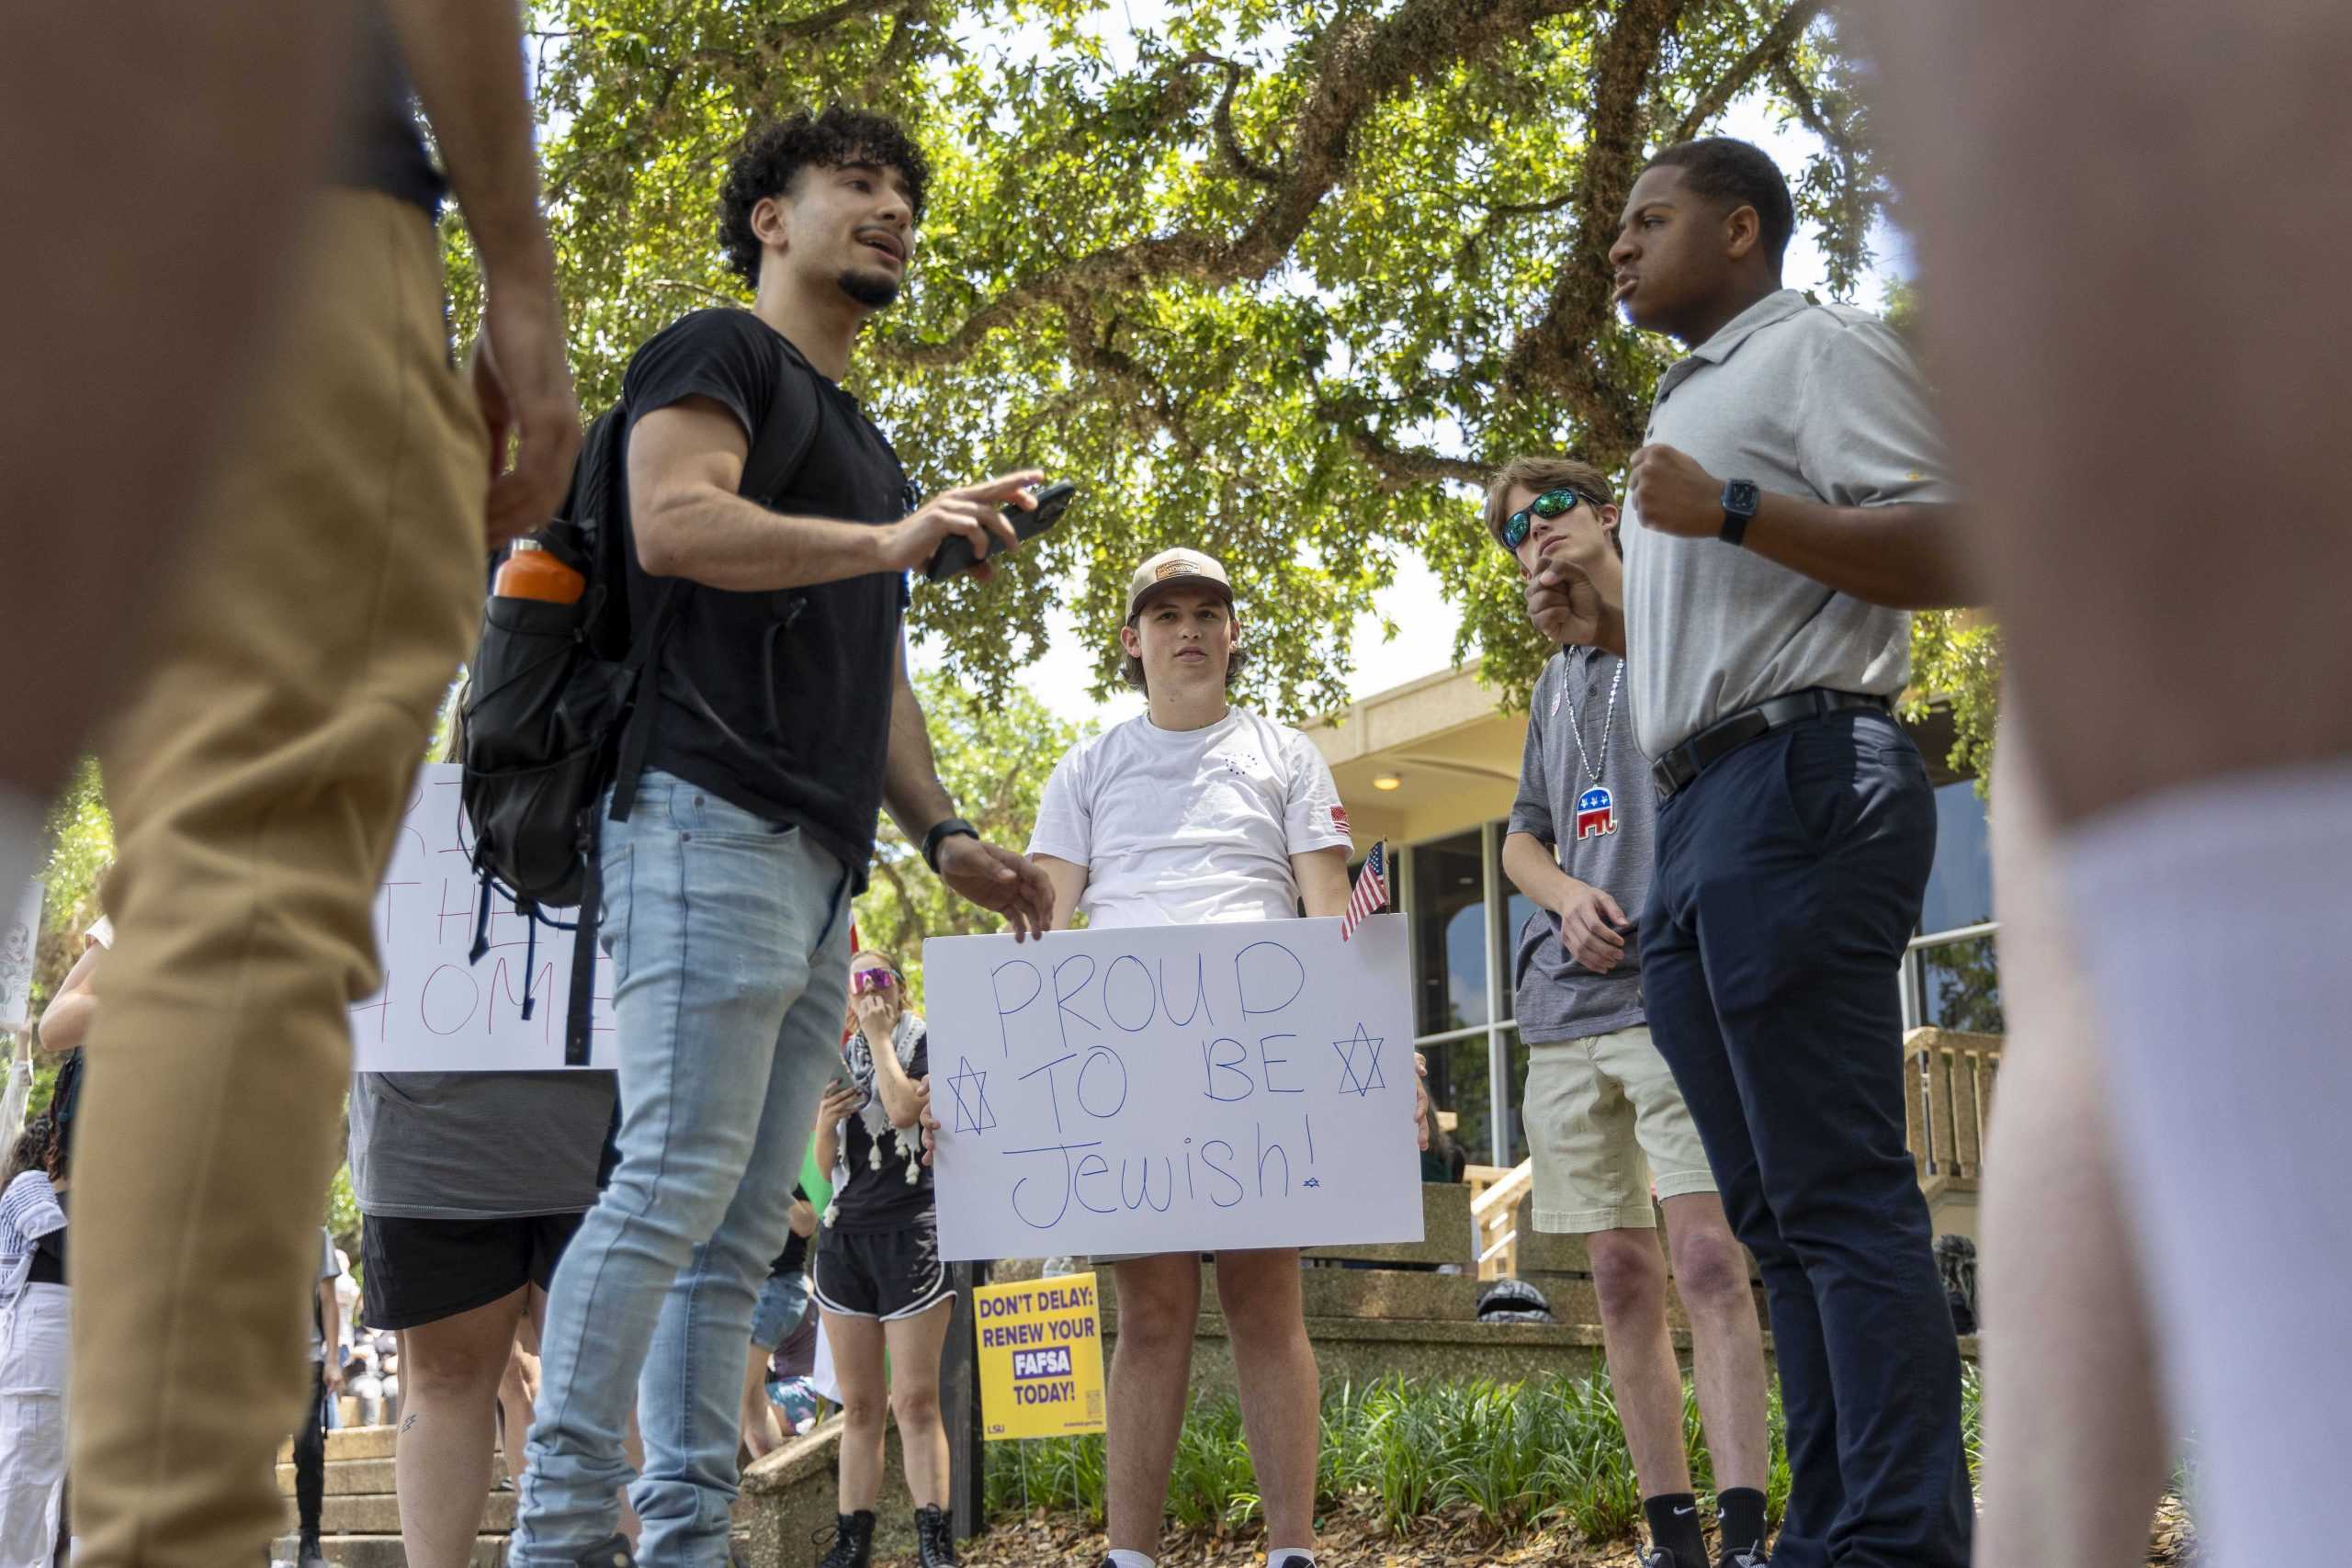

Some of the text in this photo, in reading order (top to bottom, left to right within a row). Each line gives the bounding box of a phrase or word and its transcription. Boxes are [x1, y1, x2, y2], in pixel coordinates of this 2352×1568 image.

[991, 942, 1305, 1058] PROUD
[1018, 1033, 1305, 1134] TO BE
[1002, 1113, 1321, 1229] Jewish!
[979, 1293, 1033, 1318] DON'T
[983, 1317, 1095, 1348] RENEW YOUR
[1014, 1350, 1070, 1376] FAFSA
[1013, 1382, 1075, 1405] TODAY!
[987, 1425, 1005, 1434] LSU
